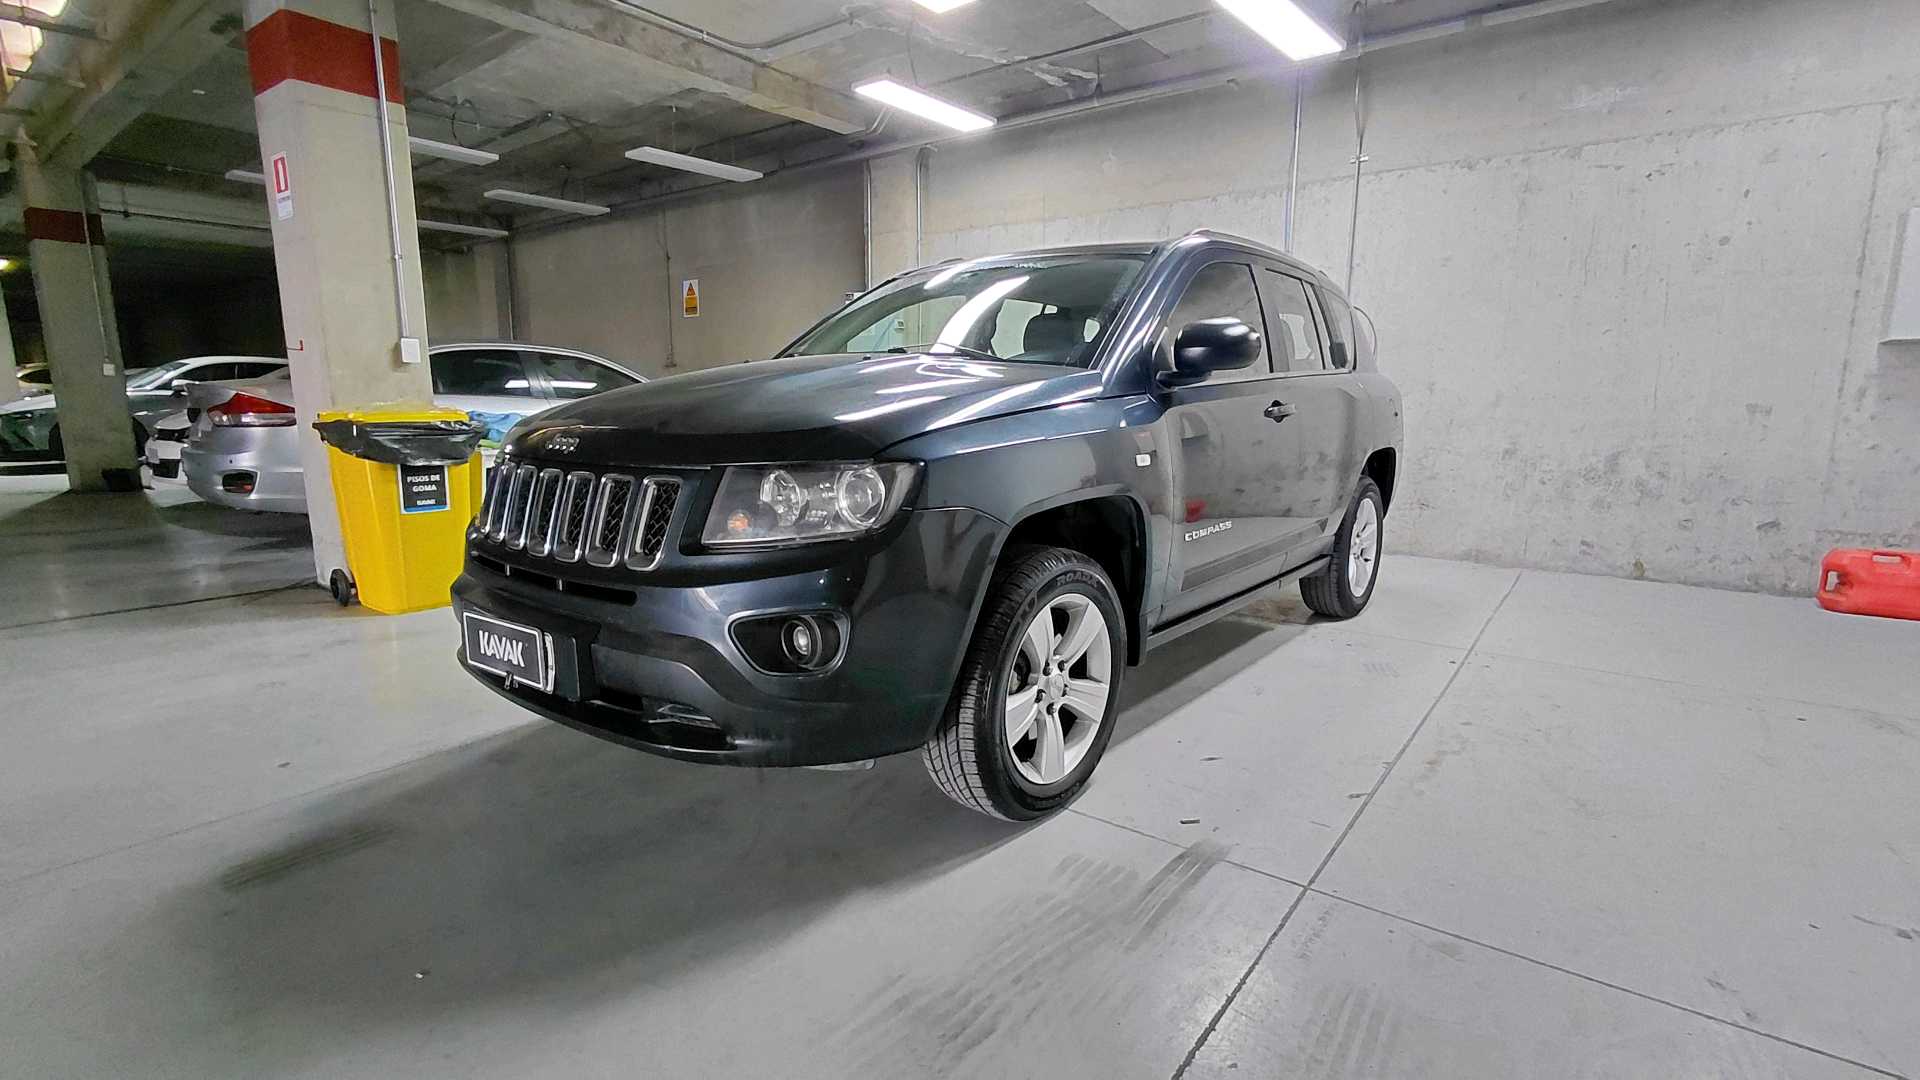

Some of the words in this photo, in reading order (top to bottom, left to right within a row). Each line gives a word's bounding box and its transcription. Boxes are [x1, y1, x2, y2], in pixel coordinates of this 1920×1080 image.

[407, 475, 429, 483] PISOS
[431, 474, 441, 482] DE
[412, 484, 438, 492] GOMA
[1185, 521, 1232, 542] COMPASS
[479, 630, 525, 667] KAVAK
